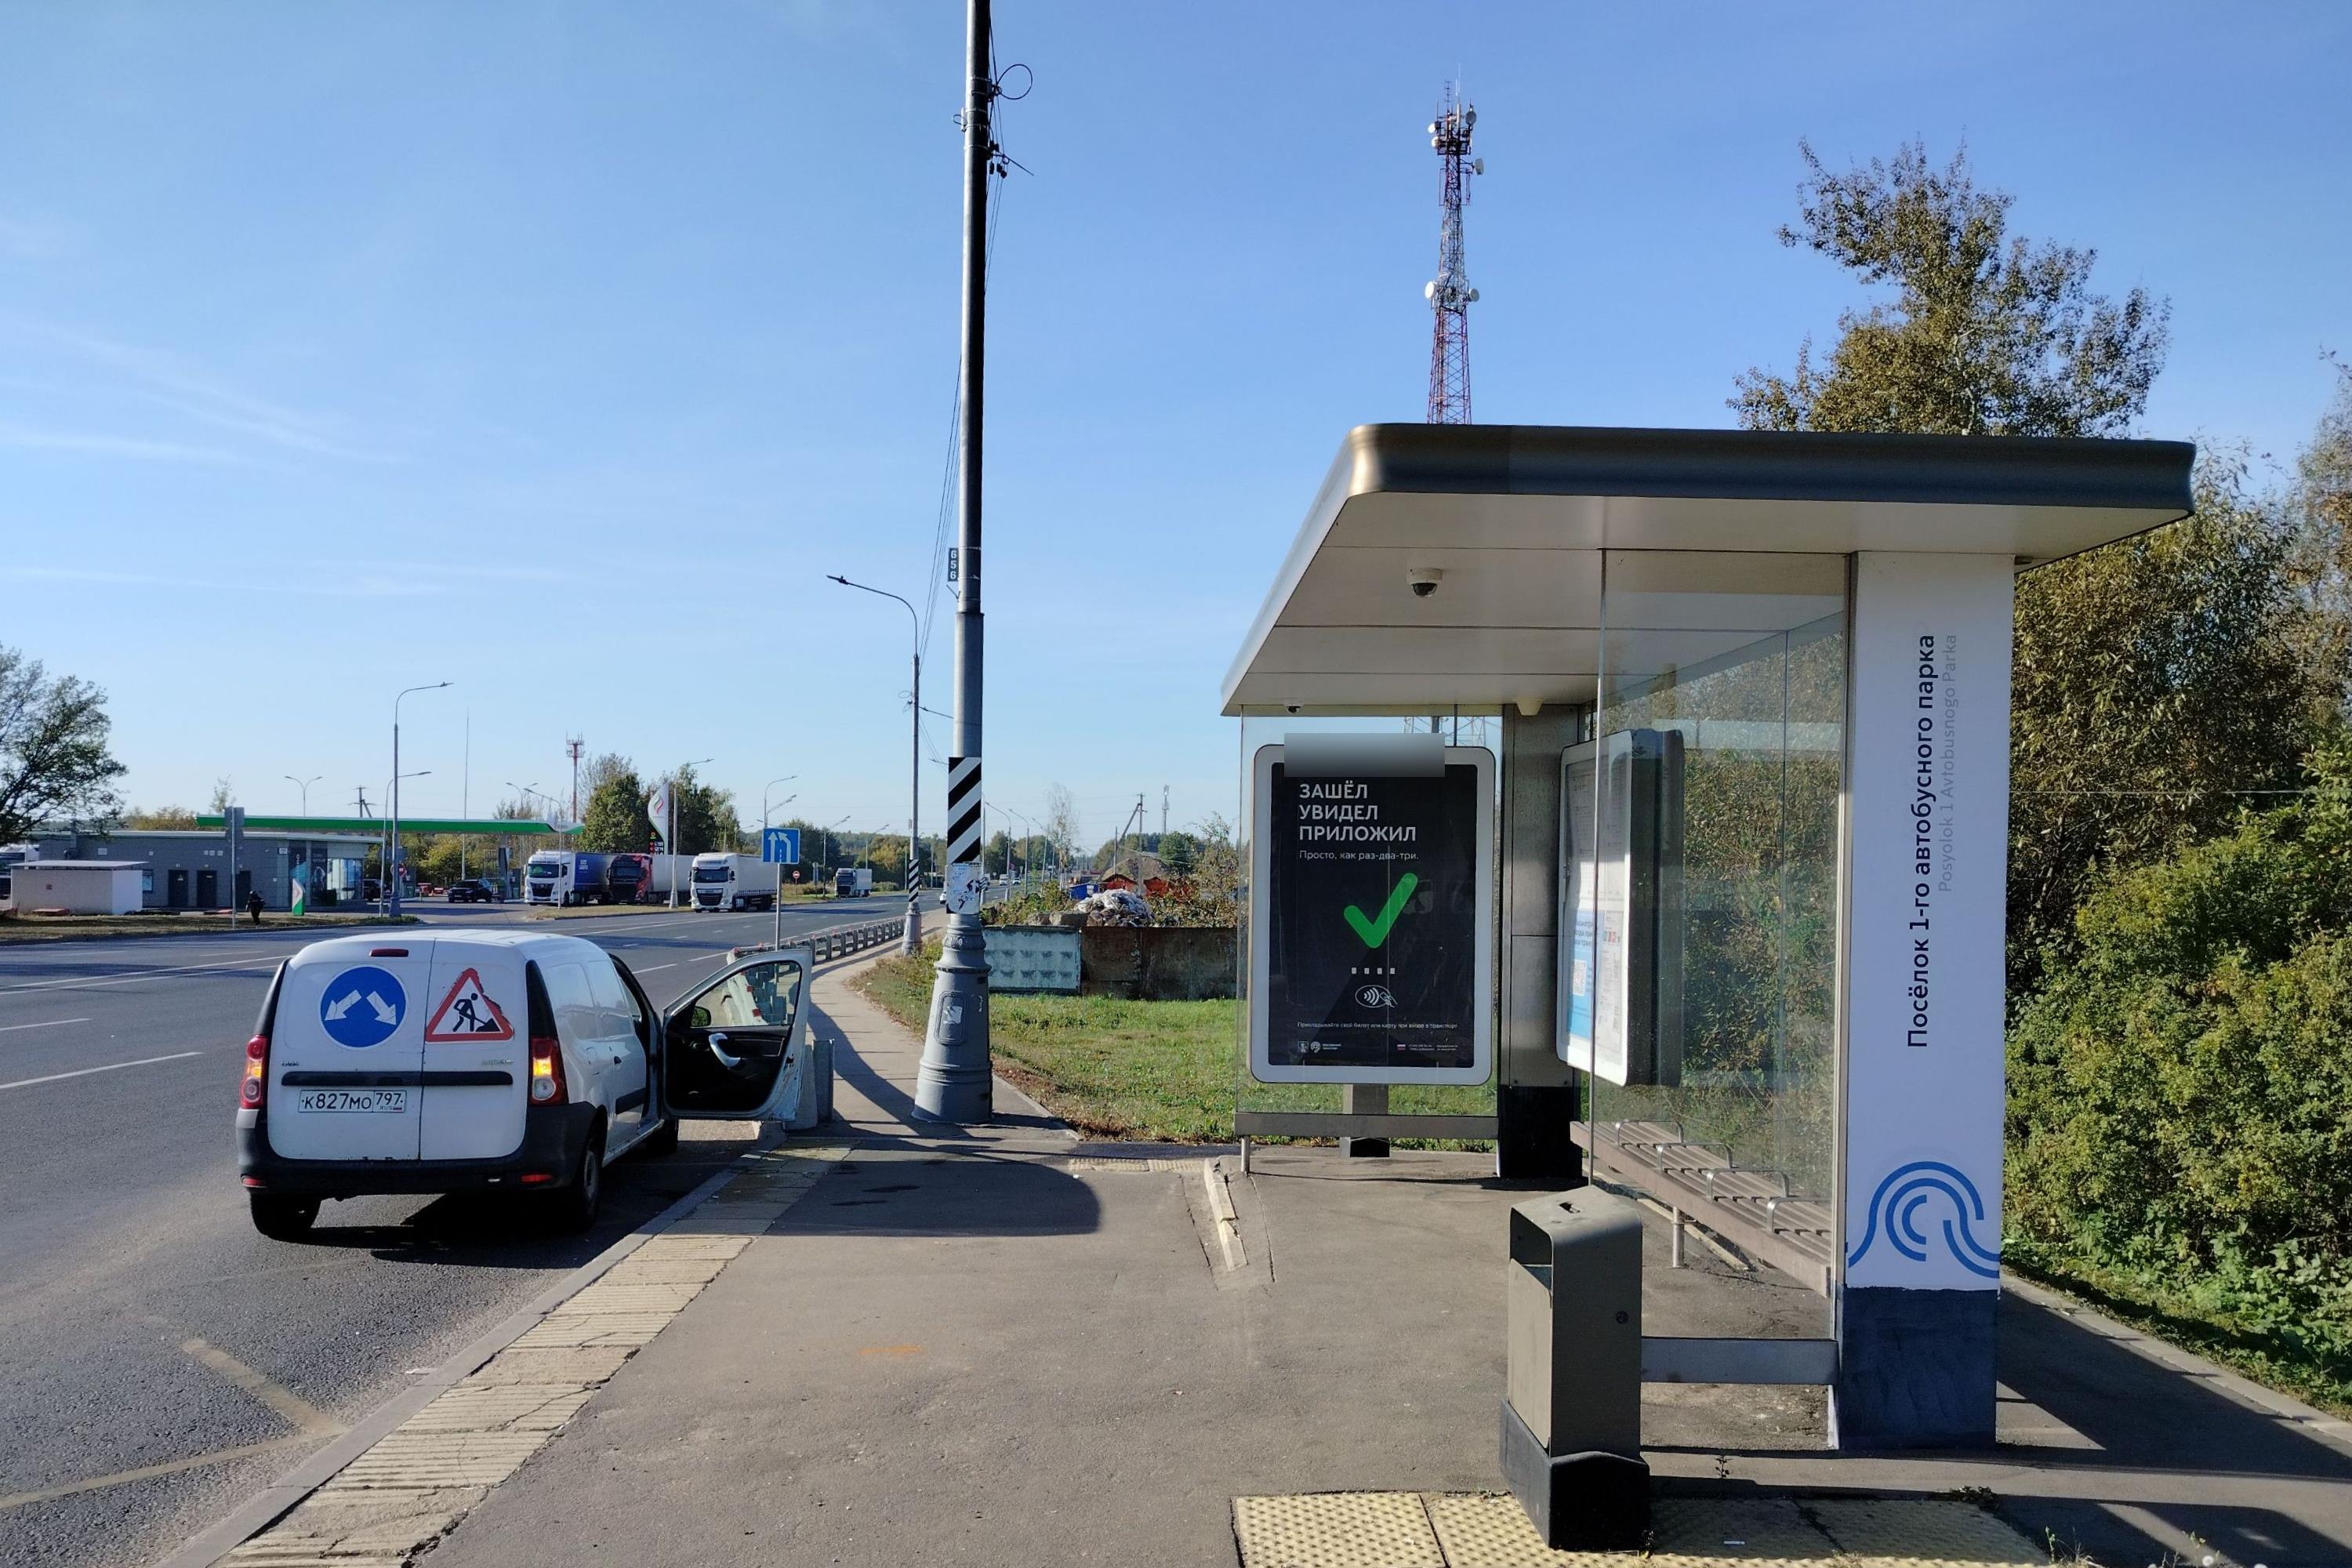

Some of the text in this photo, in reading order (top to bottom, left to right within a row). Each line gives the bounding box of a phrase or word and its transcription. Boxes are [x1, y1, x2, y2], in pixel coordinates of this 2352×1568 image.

[1938, 634, 1958, 891] Posyolok 1 Avtobusnogo Parka
[1299, 780, 1367, 799] ЗАШЁЛ
[1299, 804, 1378, 822] УВИДЕЛ
[1299, 826, 1416, 841] ПРИЛОЖИЛ
[1907, 635, 1938, 1047] Посёлок 1-го автобусного парка
[1299, 850, 1338, 861] Просто,
[1359, 852, 1419, 862] раз-два-три.
